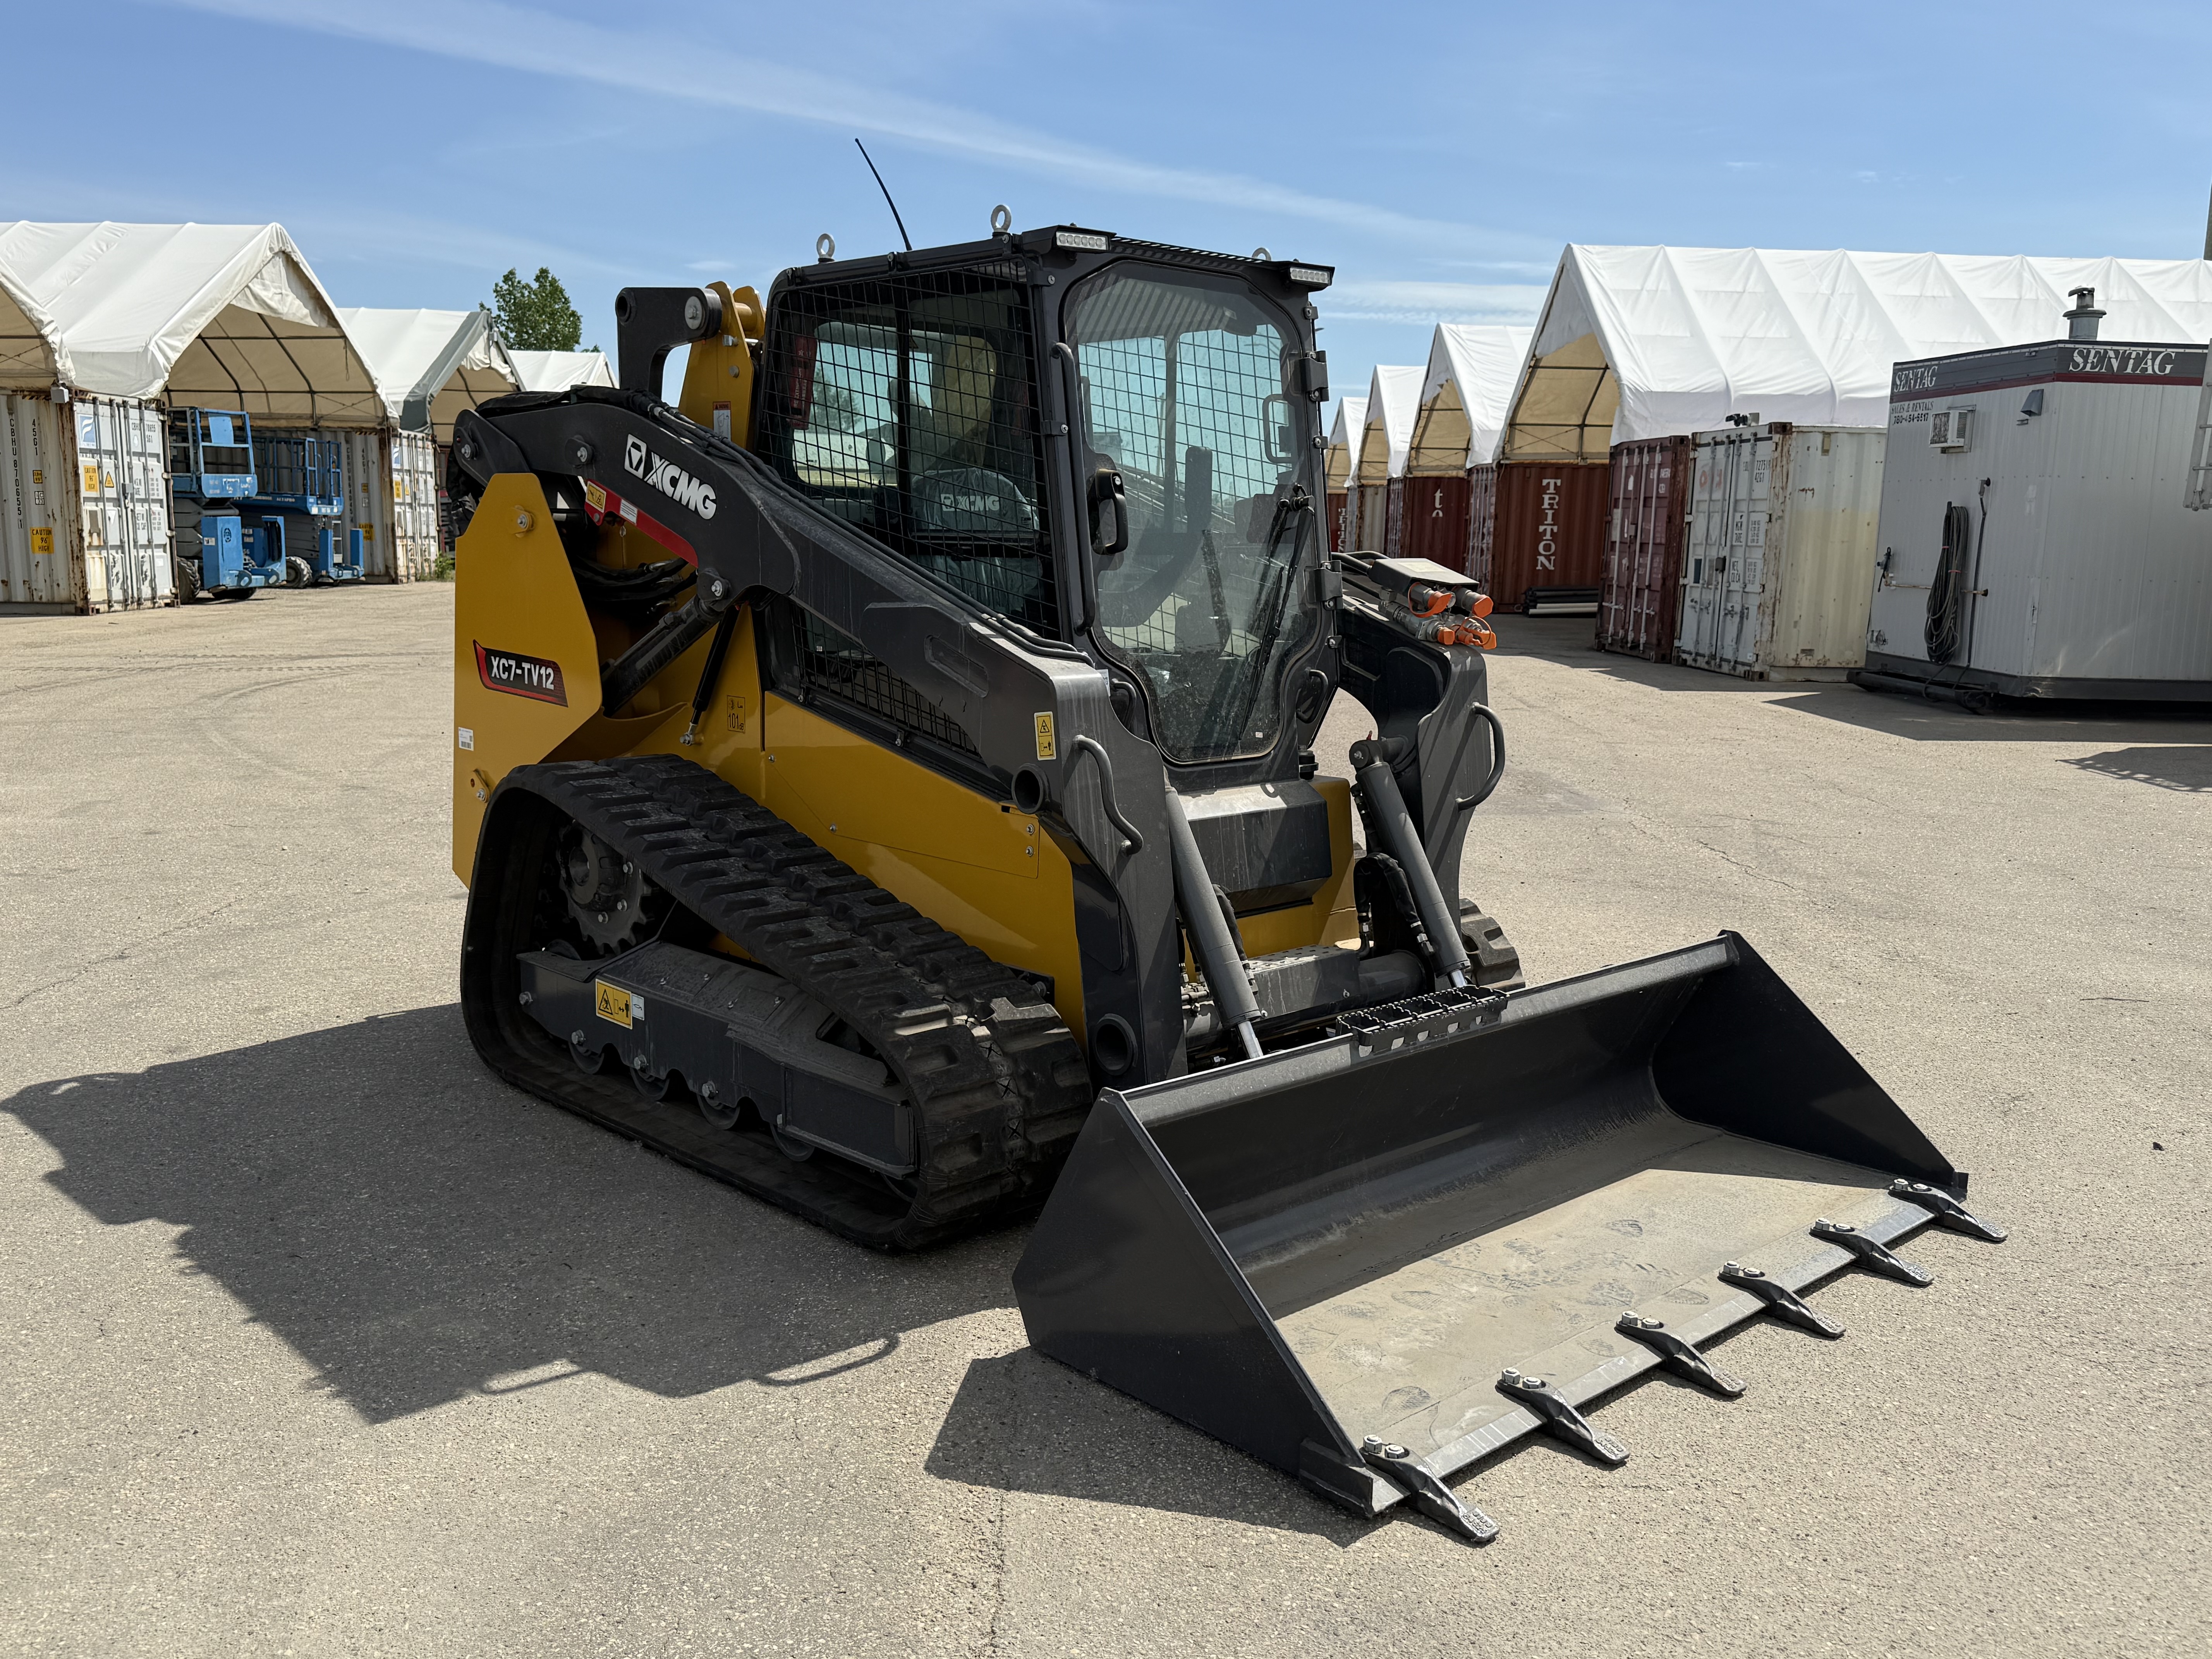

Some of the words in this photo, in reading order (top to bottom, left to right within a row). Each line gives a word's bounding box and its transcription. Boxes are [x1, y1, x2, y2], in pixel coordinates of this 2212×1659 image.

[2069, 348, 2175, 375] SENTAG
[1894, 366, 1938, 392] SENTAG
[1891, 404, 1905, 414] SALES
[1906, 403, 1910, 412] &
[1911, 401, 1934, 412] RENTALS
[644, 452, 716, 519] XCMG
[956, 496, 1000, 511] XCMG
[1536, 479, 1561, 570] TRITON
[491, 656, 554, 690] XC7-TV12
[728, 713, 739, 729] 101
